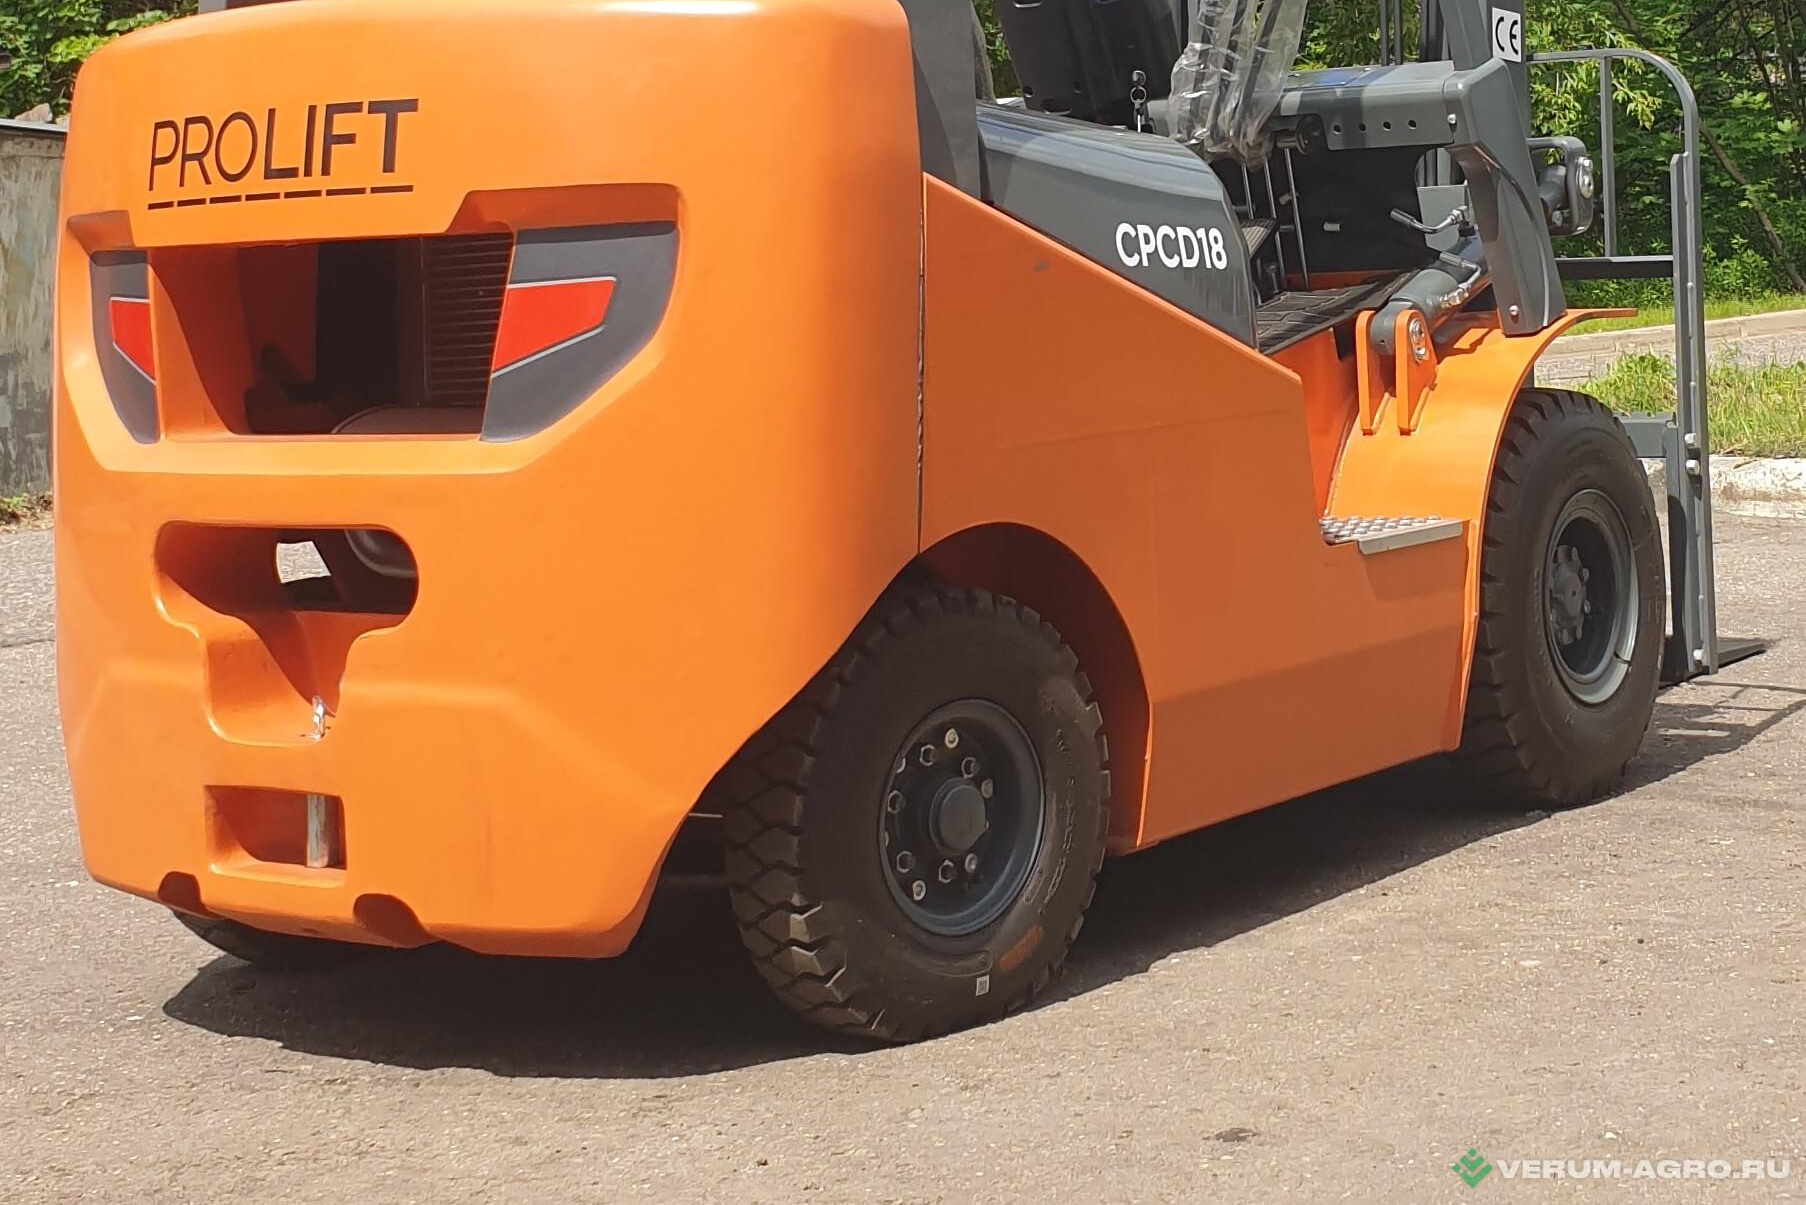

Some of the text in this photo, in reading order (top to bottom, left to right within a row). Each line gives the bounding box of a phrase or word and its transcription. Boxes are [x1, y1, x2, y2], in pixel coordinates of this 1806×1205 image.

[1495, 16, 1519, 56] CE
[148, 98, 419, 192] PROLIFT
[1115, 222, 1228, 270] CPCD18
